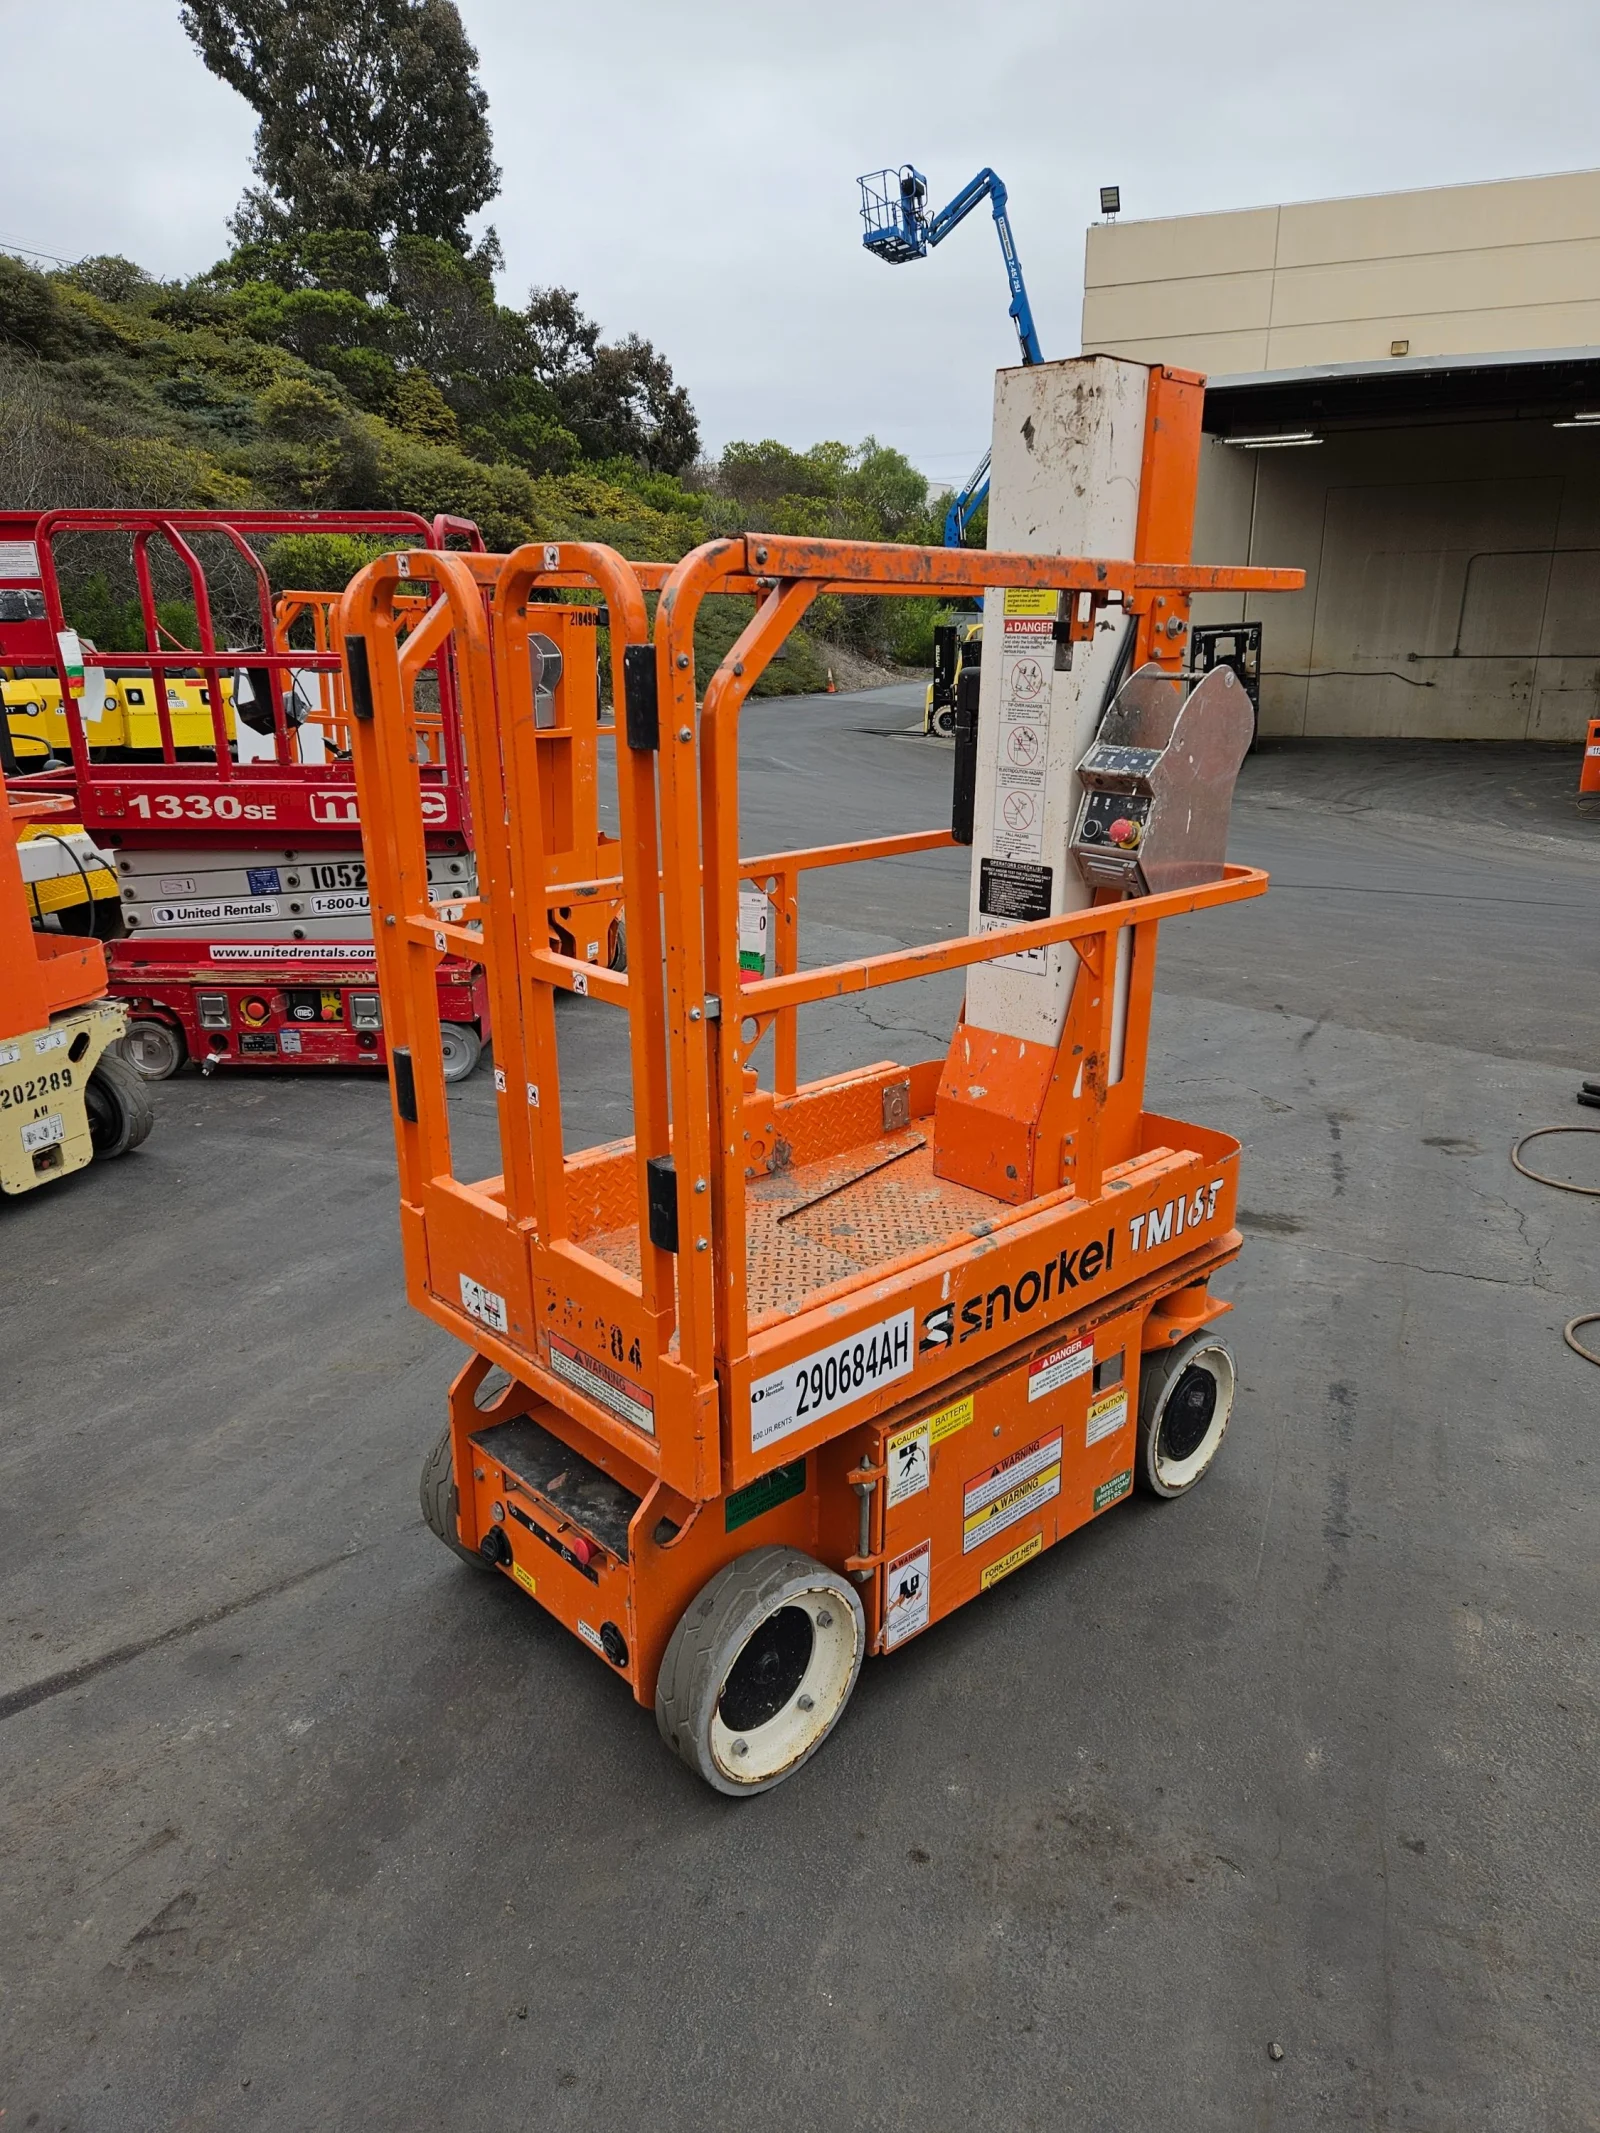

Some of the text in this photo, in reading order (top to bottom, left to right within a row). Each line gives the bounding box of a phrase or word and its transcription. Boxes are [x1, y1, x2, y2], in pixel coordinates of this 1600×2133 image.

[1014, 622, 1053, 632] DANGER
[177, 904, 272, 920] United Rentals
[296, 1008, 312, 1016] mec
[34, 1105, 48, 1119] AH
[960, 1229, 1114, 1343] snorkel
[1129, 1178, 1224, 1252] TM16T
[1049, 1340, 1082, 1366] DANGER
[584, 1356, 626, 1391] WARNING
[796, 1322, 908, 1417] 290684AH
[936, 1402, 968, 1426] BATTERY
[1097, 1393, 1124, 1414] CAUTION
[897, 1424, 928, 1446] CAUTION
[1001, 1441, 1040, 1471] WARNING
[1000, 1478, 1038, 1508] WARNING
[1100, 1473, 1126, 1493] MAXIMUM
[1115, 1478, 1130, 1491] LOAD
[985, 1539, 1039, 1579] FORK-LIFT HERE
